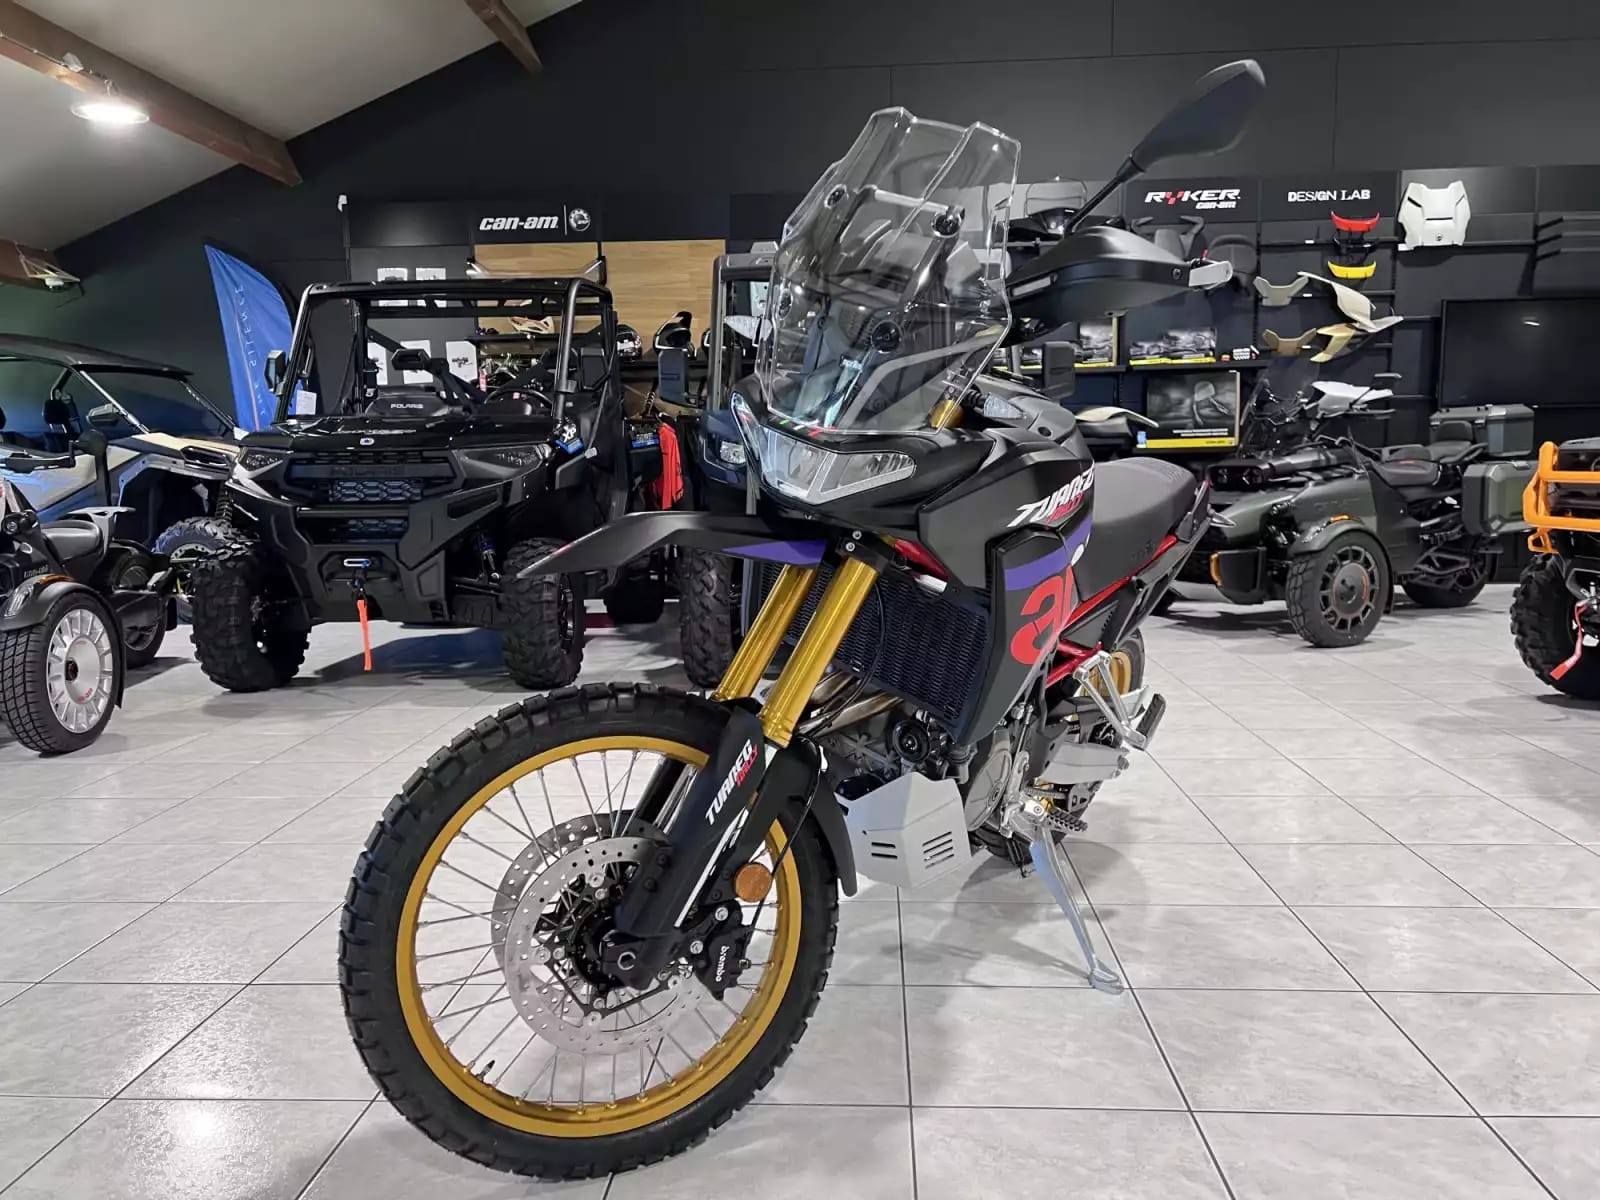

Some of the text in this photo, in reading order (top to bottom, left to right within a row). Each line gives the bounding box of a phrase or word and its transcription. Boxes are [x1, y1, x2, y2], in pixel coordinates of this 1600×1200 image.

[1145, 189, 1241, 205] RYKER
[1287, 189, 1371, 202] DESIGN LAB
[479, 216, 559, 231] can-am
[715, 945, 730, 982] brembo
